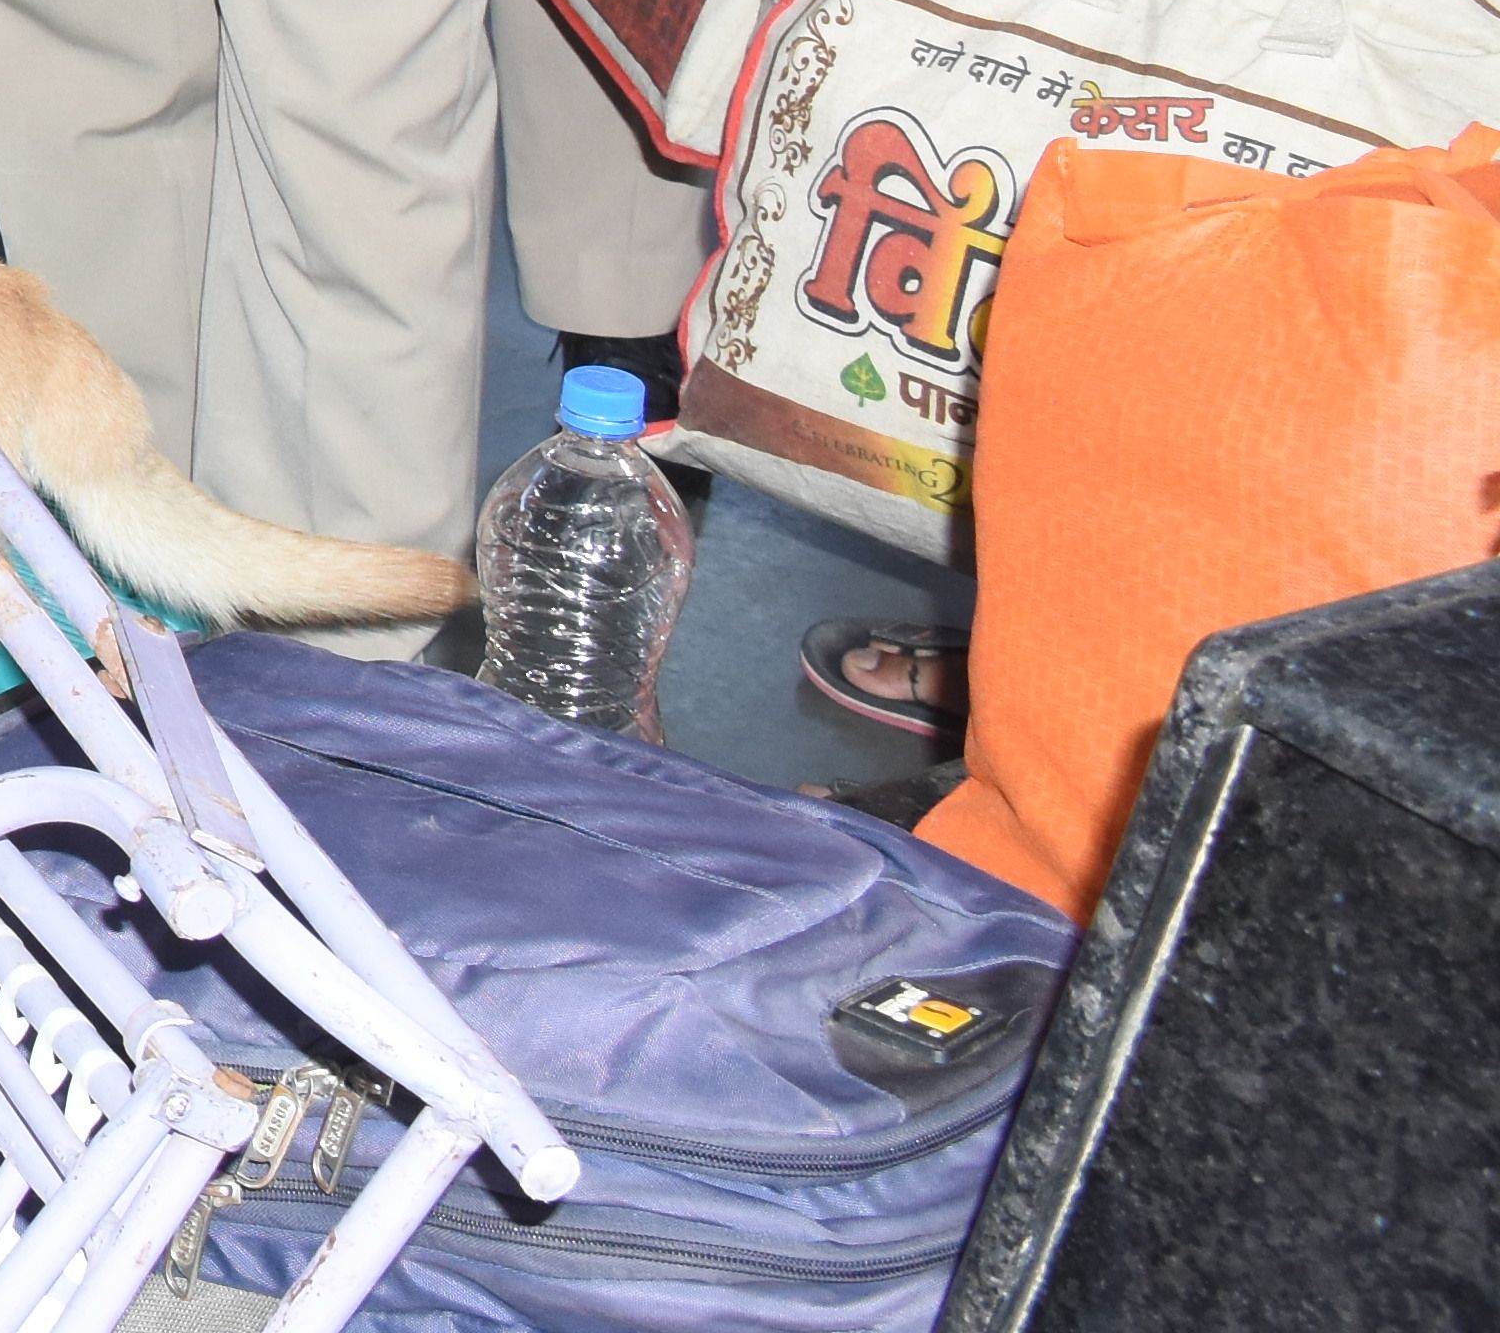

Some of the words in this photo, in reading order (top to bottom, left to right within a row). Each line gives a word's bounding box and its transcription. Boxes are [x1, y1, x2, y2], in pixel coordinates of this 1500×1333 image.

[911, 39, 965, 73] दाने
[967, 52, 1031, 94] दाने
[1036, 70, 1074, 108] में
[1069, 80, 1214, 142] केसर
[1222, 132, 1276, 171] का
[798, 111, 1011, 371] वि
